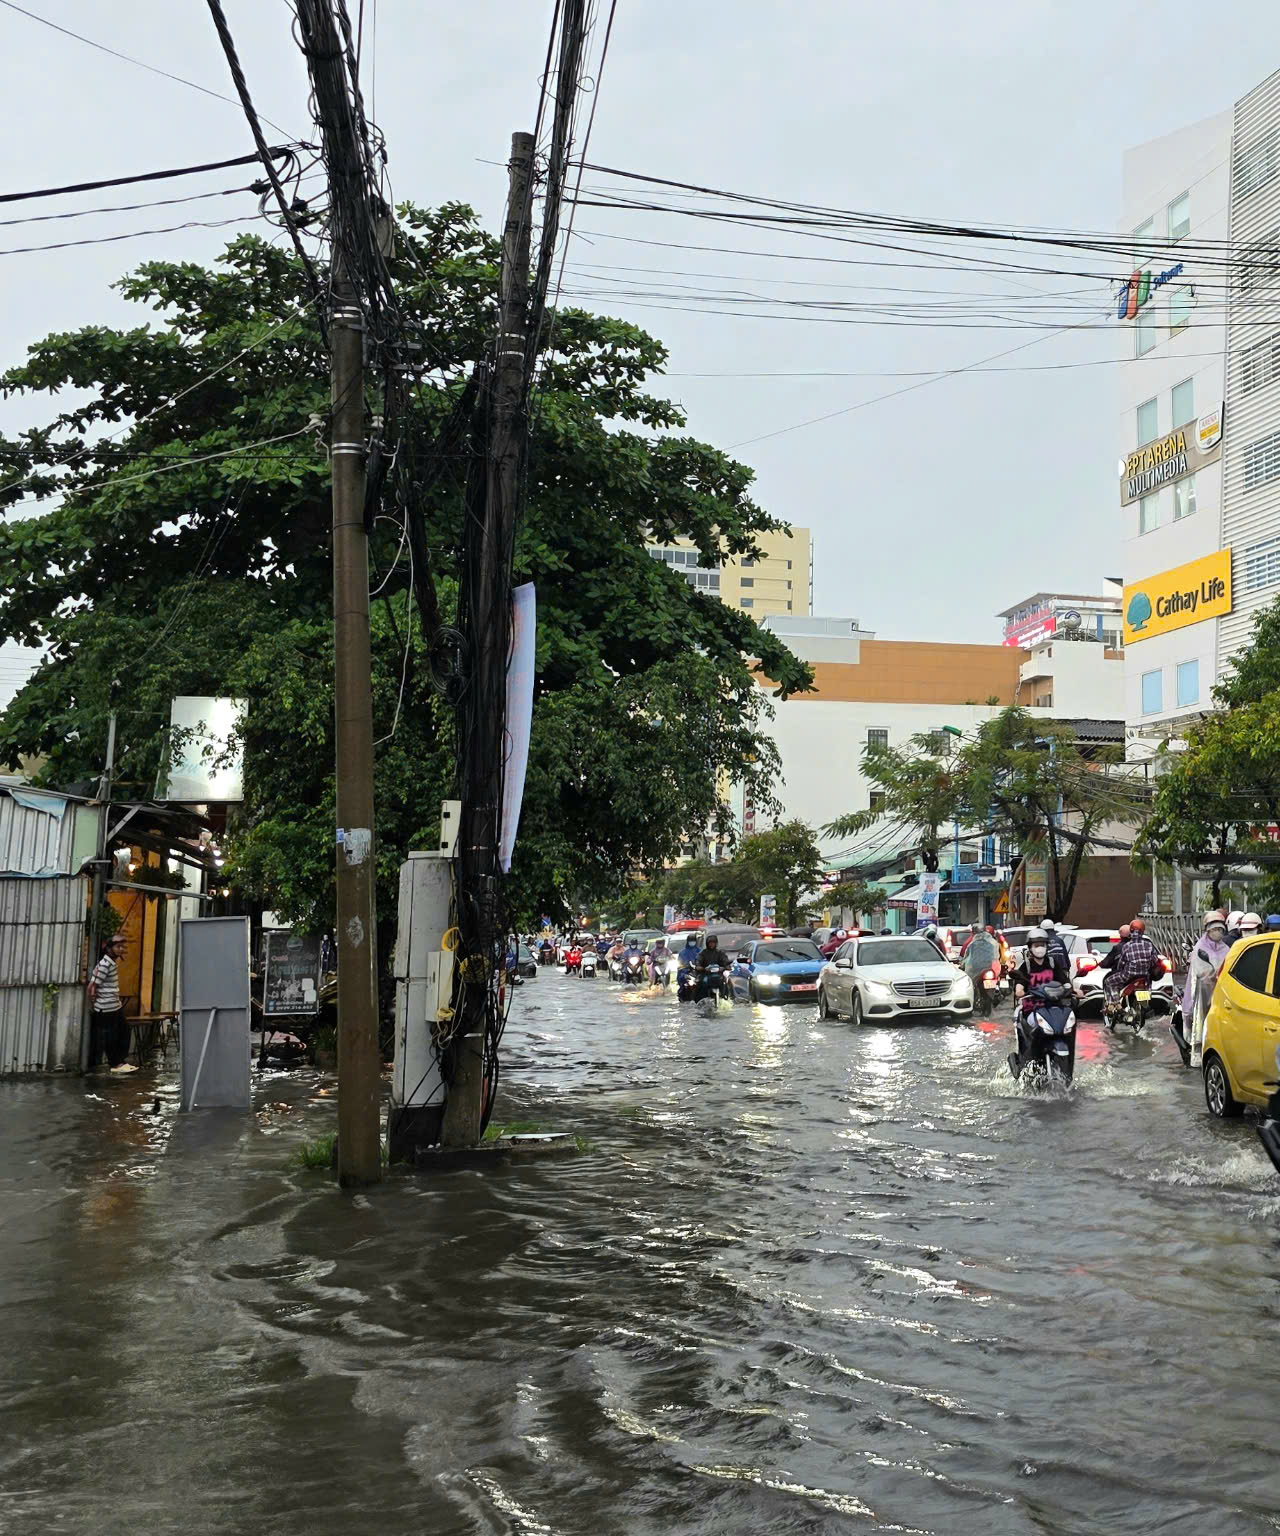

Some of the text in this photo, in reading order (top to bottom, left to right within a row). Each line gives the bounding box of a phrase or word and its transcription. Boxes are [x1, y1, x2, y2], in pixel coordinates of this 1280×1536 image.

[1127, 450, 1147, 478] FPT
[1149, 431, 1187, 469] ARENA
[1127, 454, 1188, 498] MULTIMEDIA
[1156, 577, 1225, 617] Cathay Life
